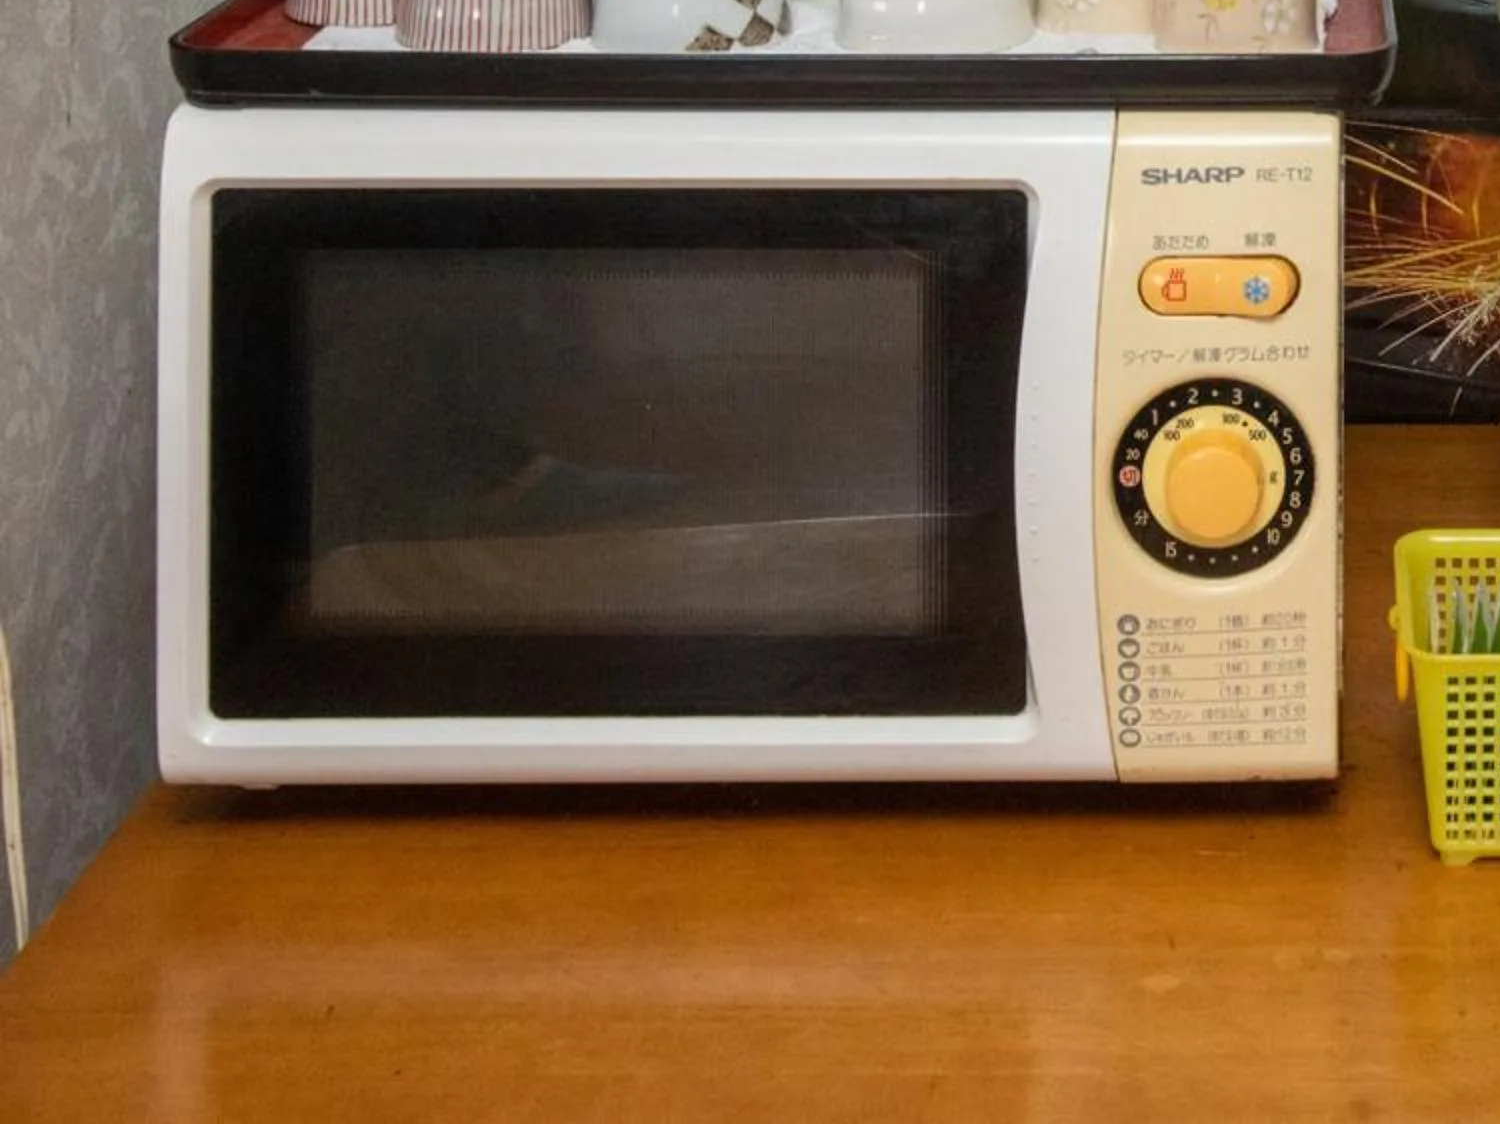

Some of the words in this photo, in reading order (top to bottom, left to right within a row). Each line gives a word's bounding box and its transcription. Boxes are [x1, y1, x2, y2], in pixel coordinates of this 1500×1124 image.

[1140, 166, 1246, 186] SHARP
[1255, 167, 1313, 182] RE-T12
[1187, 388, 1199, 404] 2
[1231, 388, 1244, 405] 3
[1267, 410, 1280, 426] 4
[1176, 418, 1195, 429] 200
[1249, 429, 1267, 441] 500
[1282, 428, 1293, 445] 5
[1125, 448, 1140, 461] 20
[1289, 448, 1302, 464] 6
[1293, 470, 1305, 486] 7
[1290, 491, 1301, 508] 8
[1281, 511, 1293, 527] 9
[1267, 529, 1281, 545] 10
[1165, 542, 1177, 558] 15
